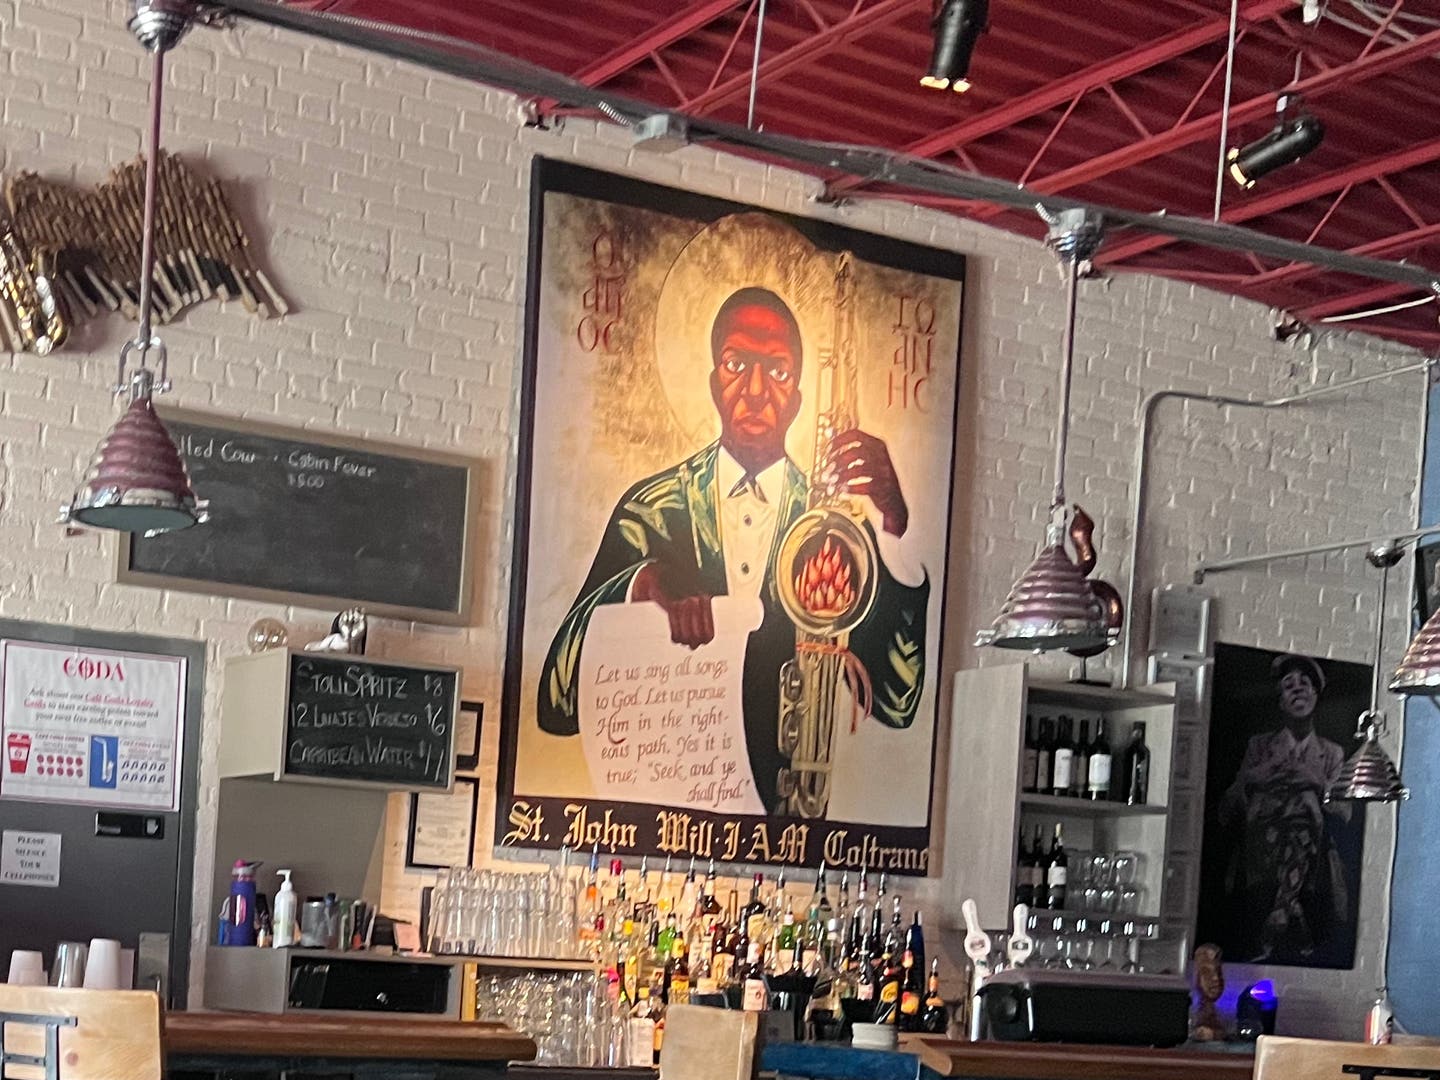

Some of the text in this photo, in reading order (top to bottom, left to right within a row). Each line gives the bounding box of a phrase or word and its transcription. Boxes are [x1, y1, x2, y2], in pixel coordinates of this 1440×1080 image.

[220, 440, 256, 464] Cow
[288, 449, 329, 471] Cabin
[333, 455, 377, 478] Fever
[63, 656, 124, 681] CODA
[595, 656, 729, 684] Let us sing all songs
[596, 694, 608, 710] to
[645, 687, 668, 705] Let
[669, 690, 685, 703] us
[687, 685, 727, 708] pursue
[291, 702, 309, 728] 12
[638, 713, 651, 731] in
[661, 709, 683, 728] the
[676, 734, 700, 757] Yes
[705, 732, 715, 752] it
[722, 732, 733, 752] is
[690, 756, 719, 776] and
[722, 758, 737, 781] ye
[686, 779, 715, 803] shall
[500, 800, 551, 848] St.
[563, 804, 638, 854] John
[823, 830, 930, 871] Coltrane
